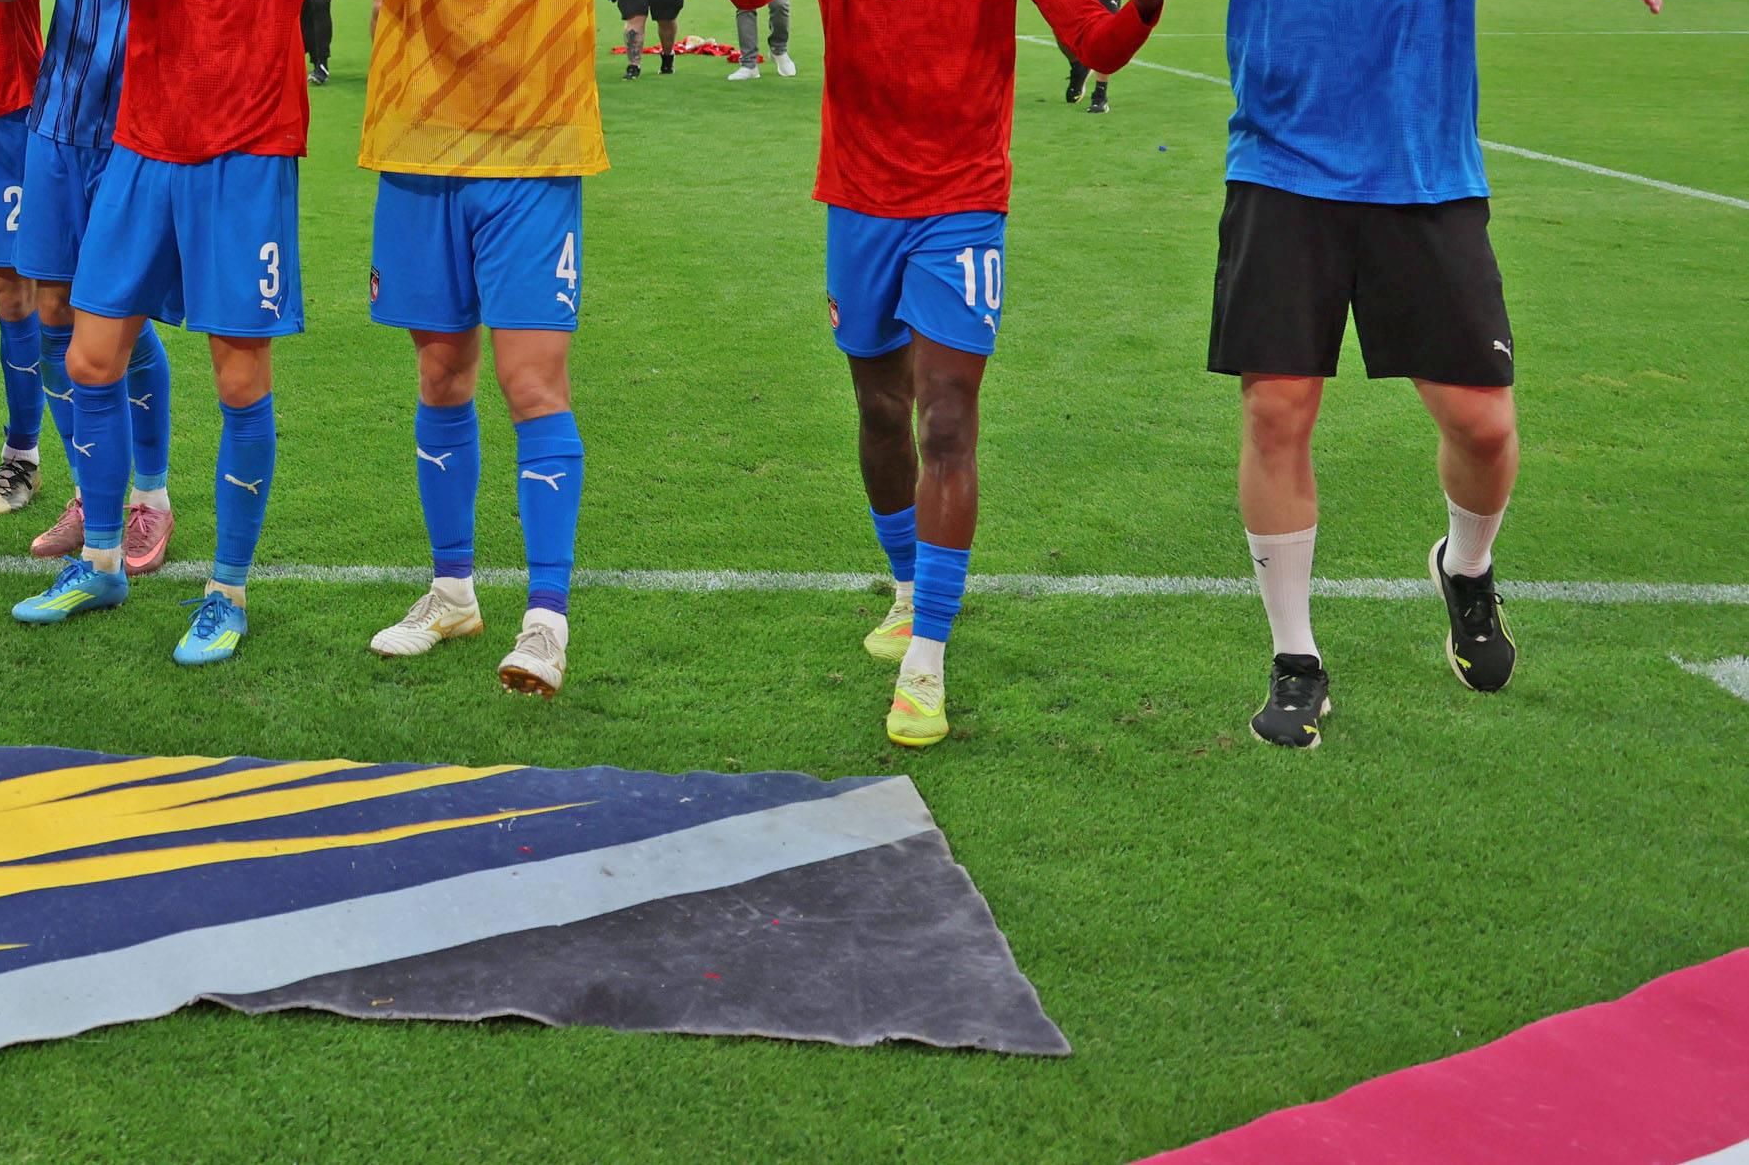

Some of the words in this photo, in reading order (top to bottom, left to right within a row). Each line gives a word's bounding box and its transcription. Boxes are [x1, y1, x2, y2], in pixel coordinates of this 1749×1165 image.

[259, 241, 281, 298] 3
[555, 231, 578, 289] 4
[956, 247, 1002, 310] 10
